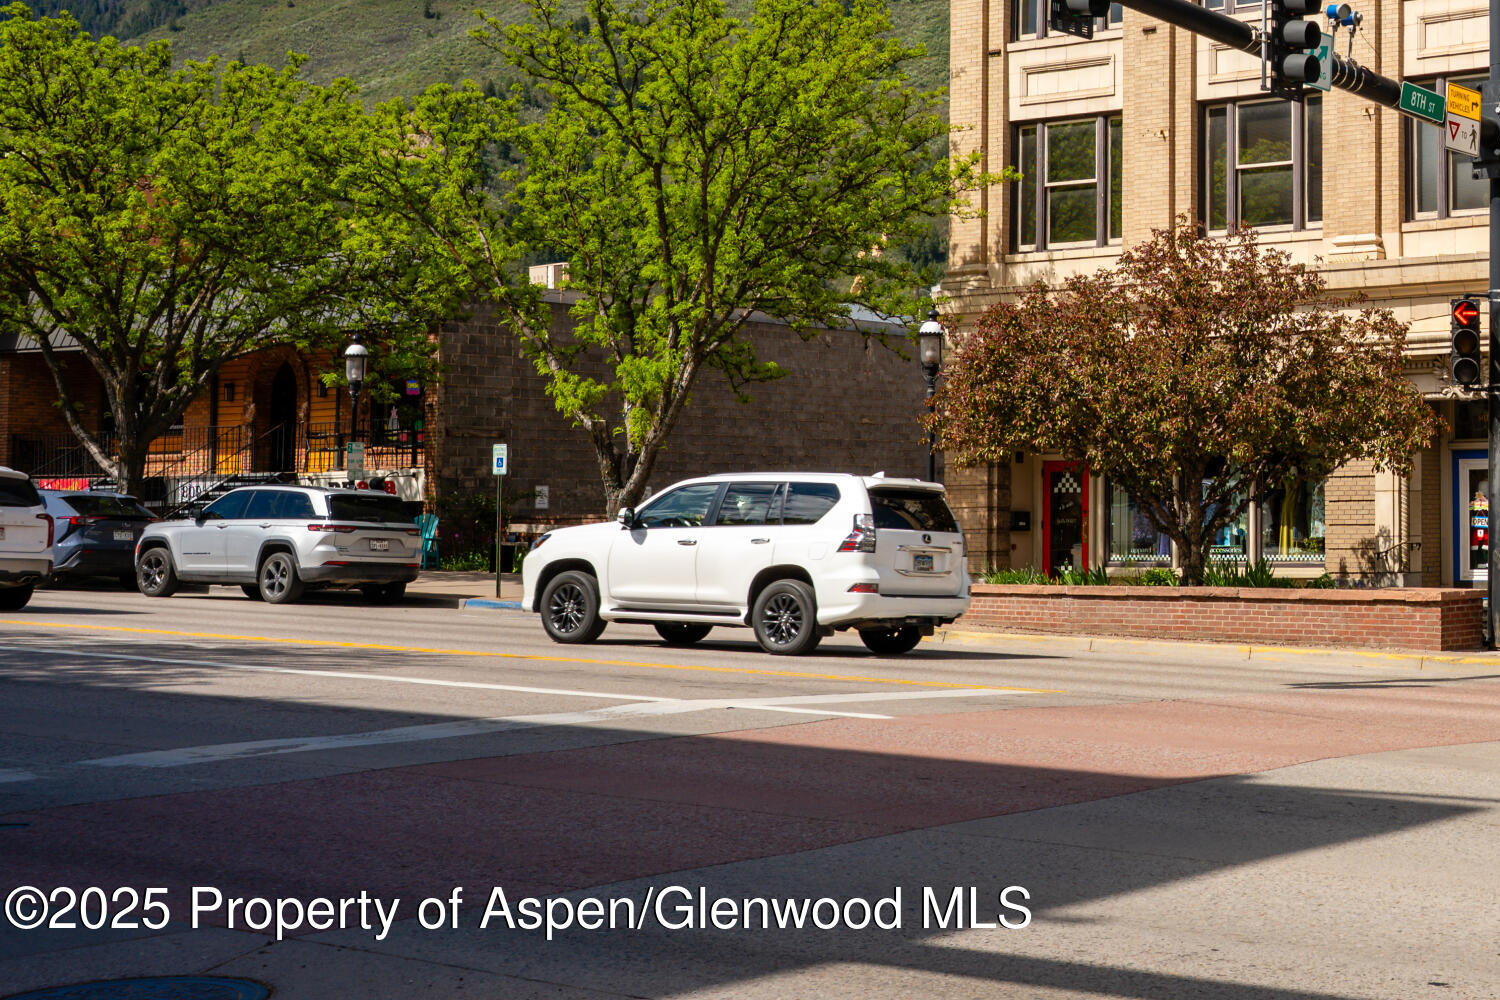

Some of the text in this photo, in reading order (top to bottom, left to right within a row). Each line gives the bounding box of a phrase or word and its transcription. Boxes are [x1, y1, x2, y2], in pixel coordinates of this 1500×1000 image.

[1411, 91, 1436, 113] 8TH ST
[1450, 89, 1470, 102] TURNING
[1449, 100, 1470, 113] VEHICLES
[1461, 131, 1468, 140] TO
